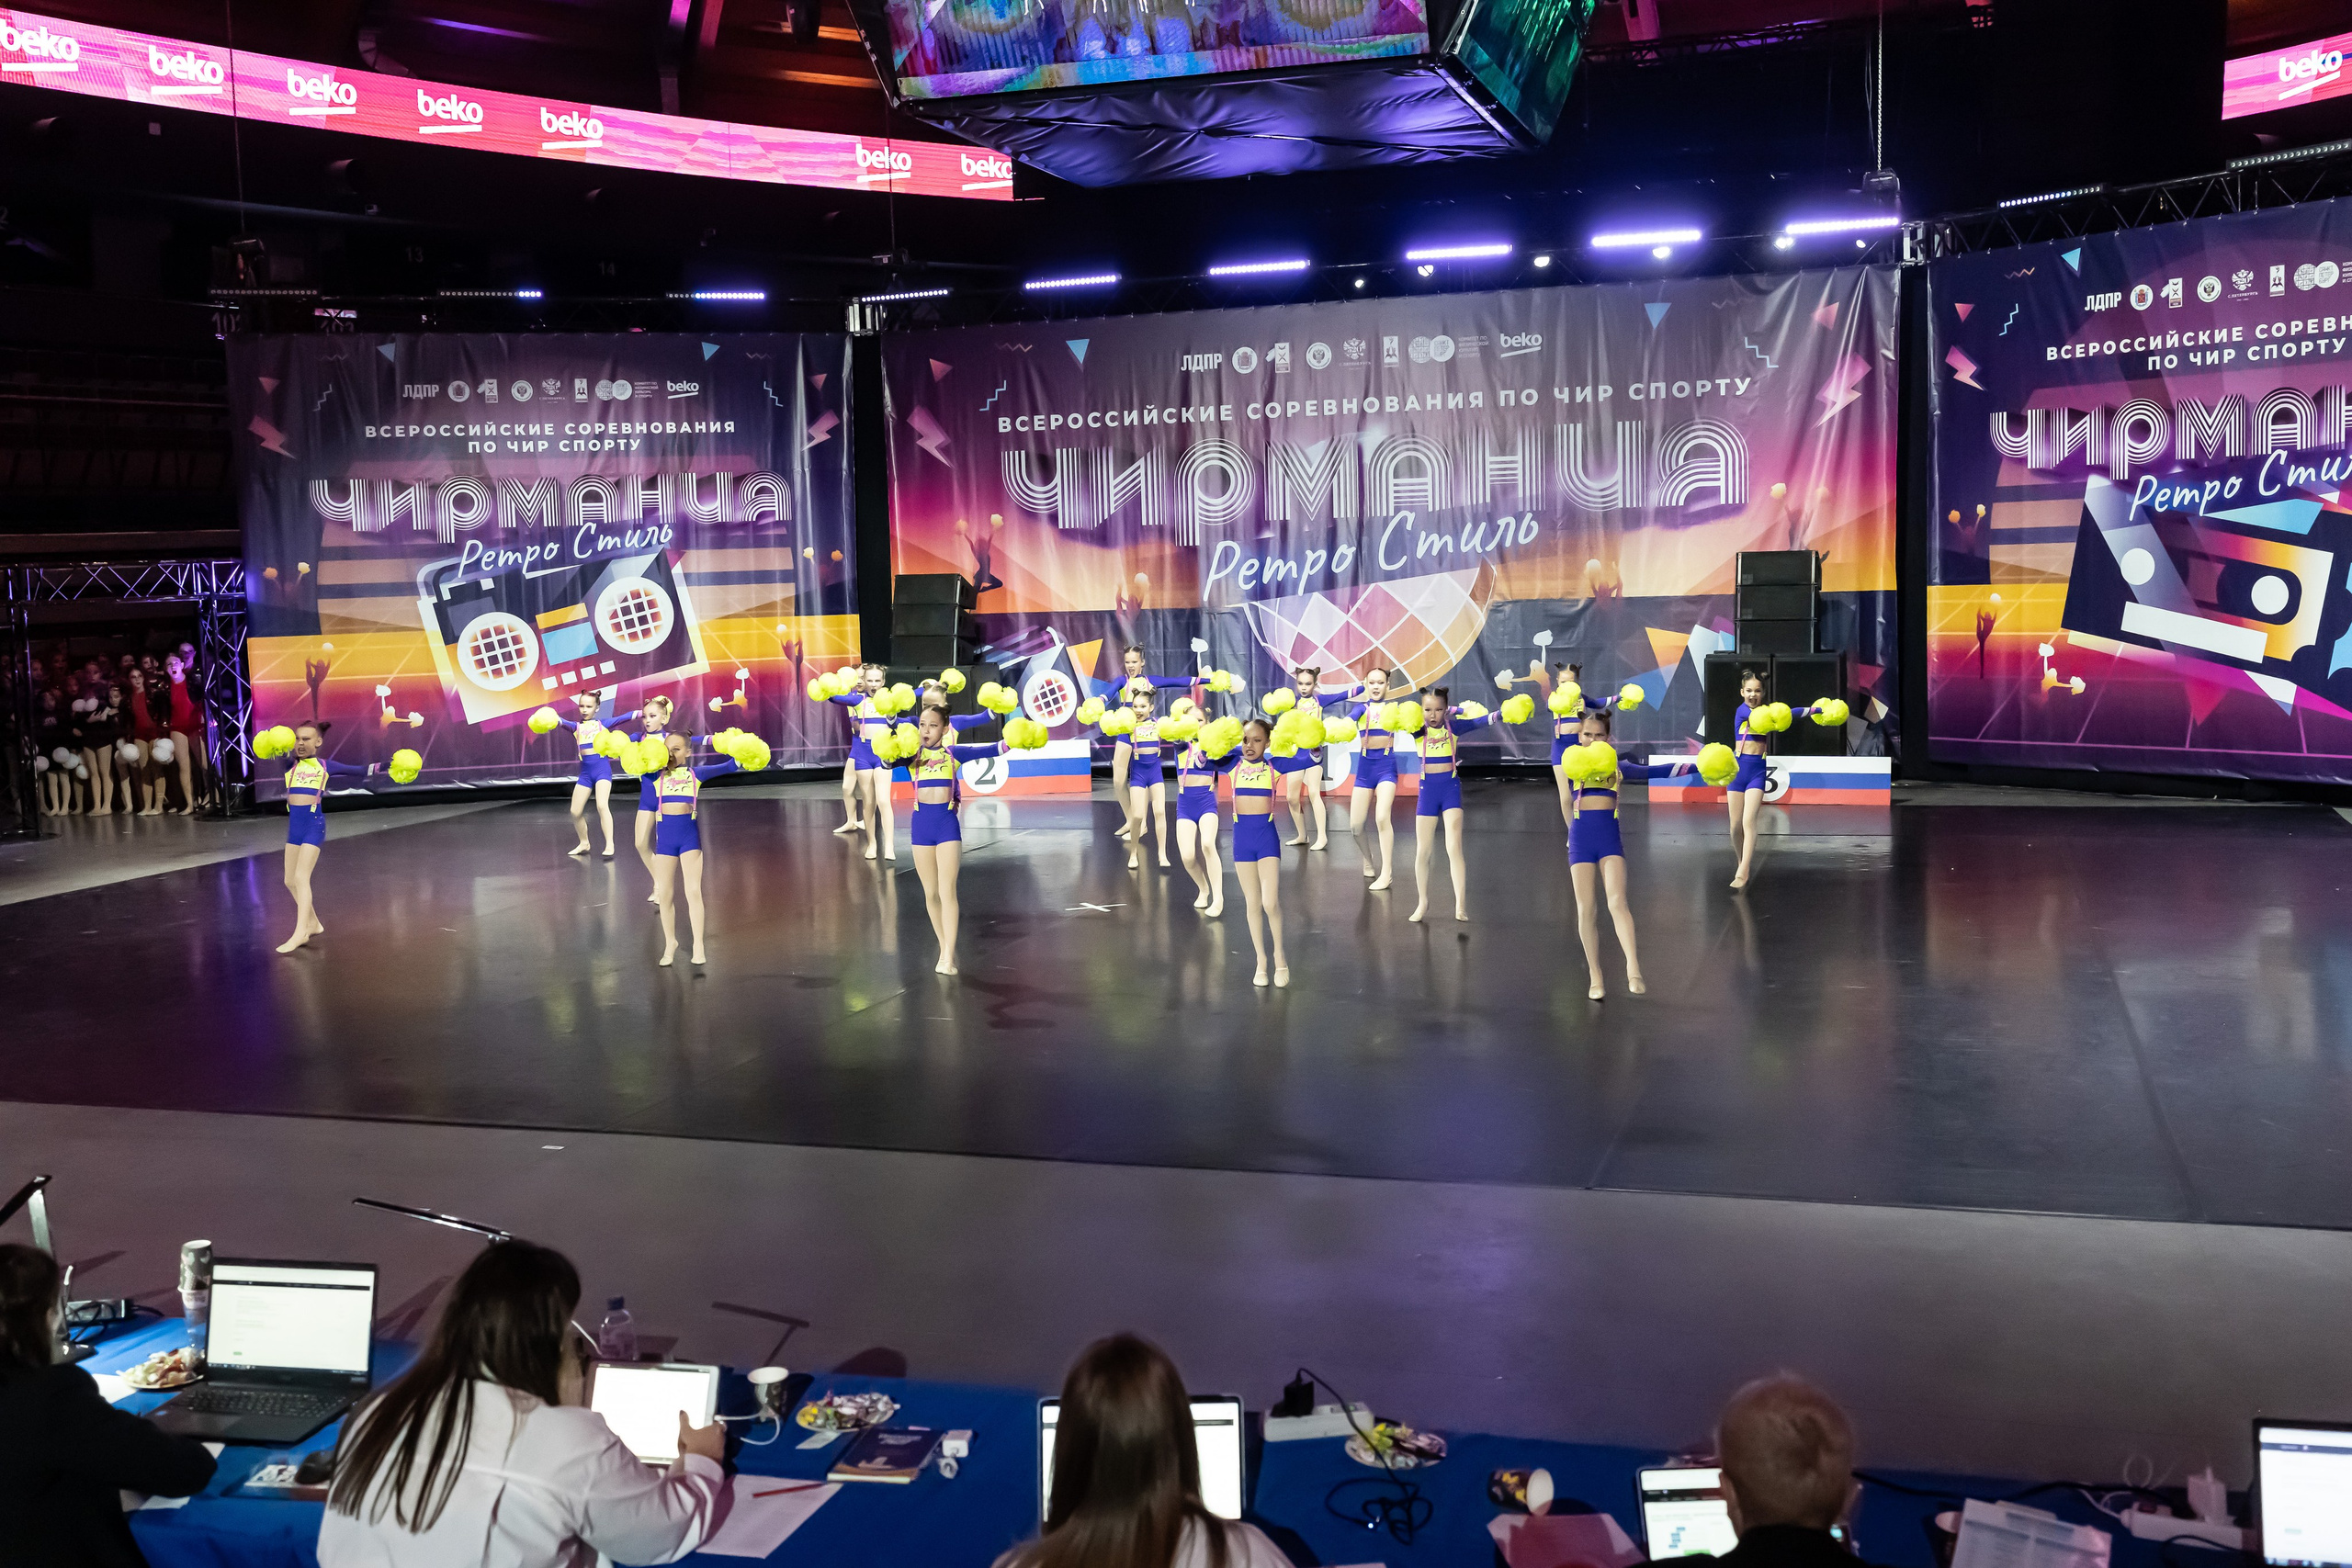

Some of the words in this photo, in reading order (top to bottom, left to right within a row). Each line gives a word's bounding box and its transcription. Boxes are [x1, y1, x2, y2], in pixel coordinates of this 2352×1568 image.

[0, 18, 79, 62] beko
[148, 45, 224, 85] beko
[2278, 50, 2343, 82] beko
[287, 68, 357, 107] beko
[417, 89, 484, 124] beko
[540, 107, 604, 140] beko
[856, 143, 912, 172] beko
[2085, 292, 2121, 311] ЛДПР
[1499, 332, 1543, 348] beko
[2046, 325, 2244, 362] ВСЕРОССИЙСКИЕ
[2148, 355, 2178, 371] ПО
[2189, 349, 2236, 367] ЧИР
[2247, 337, 2346, 363] СПОРТУ
[1181, 354, 1223, 373] ЛДПР
[402, 384, 440, 400] ЛДПР
[667, 380, 699, 392] beko
[998, 404, 1233, 433] ВСЕРОССИЙСКИЕ
[1247, 390, 1484, 420] СОРЕВНОВАНИЯ
[1499, 389, 1539, 407] ПО
[1554, 385, 1613, 404] ЧИР
[1629, 377, 1752, 400] СПОРТУ
[365, 421, 555, 438] ВСЕРОССИЙСКИЕ
[564, 421, 736, 436] СОРЕВНОВАНИЯ
[469, 440, 497, 454] ПО
[506, 439, 549, 453] ЧИР
[559, 437, 641, 452] СПОРТУ
[2129, 474, 2242, 522] Ретро
[459, 539, 560, 578] Ретро
[573, 521, 673, 558] Стиль
[1204, 540, 1357, 603] Ретро
[1377, 510, 1539, 571] Стиль
[974, 757, 997, 785] 2
